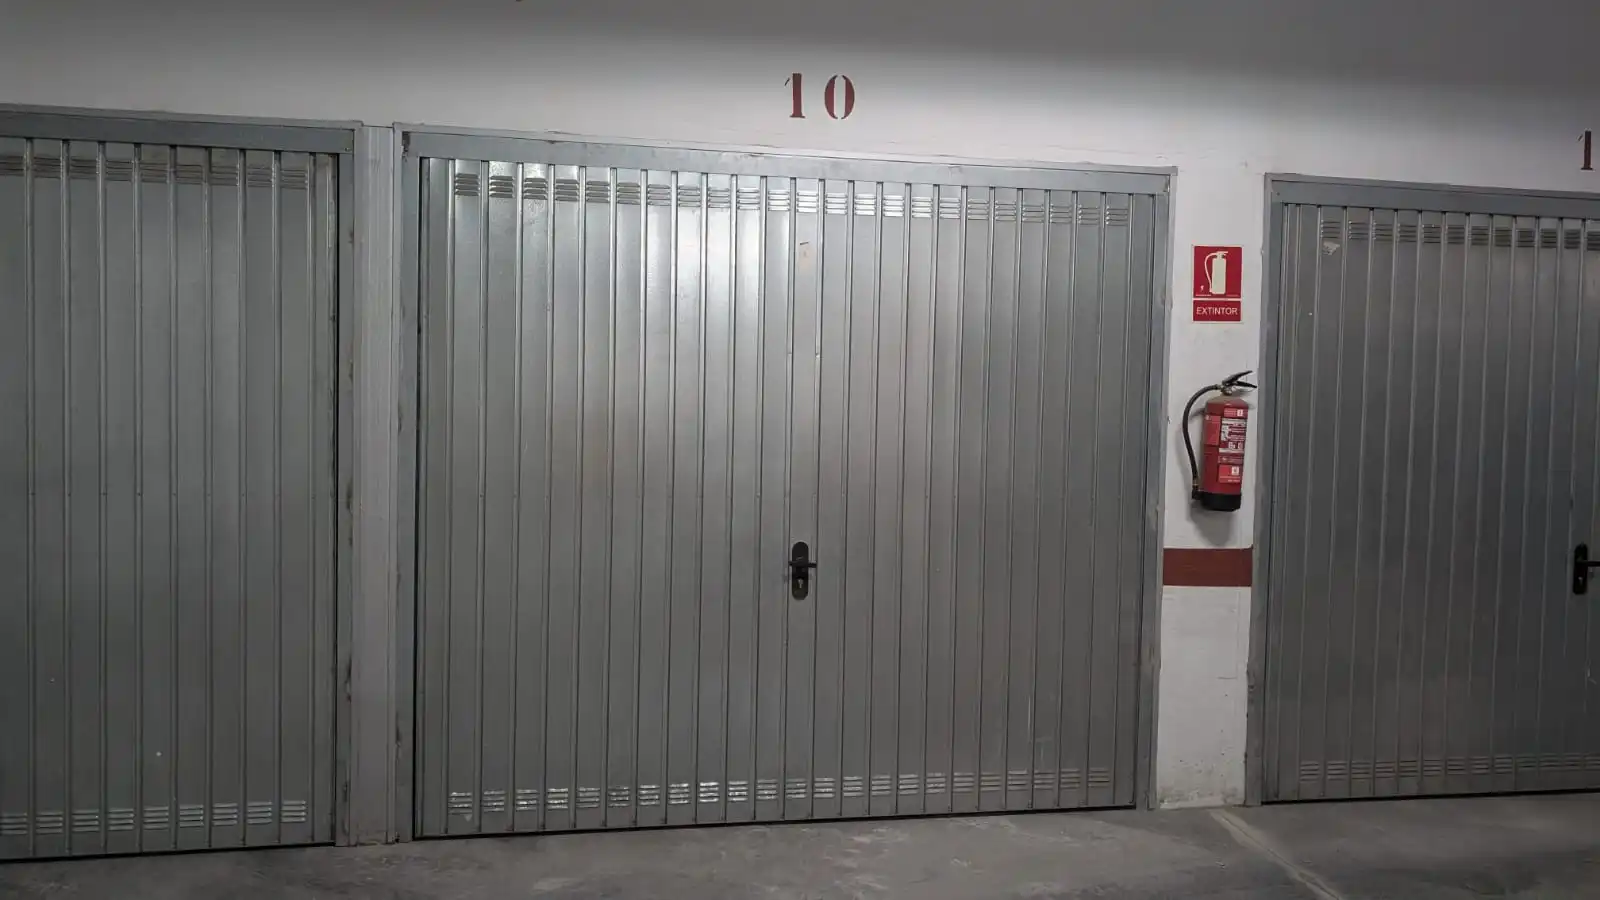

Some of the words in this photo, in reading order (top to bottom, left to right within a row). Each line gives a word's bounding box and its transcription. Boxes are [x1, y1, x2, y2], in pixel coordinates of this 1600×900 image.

[784, 73, 855, 119] 10
[1577, 130, 1594, 170] 1
[1196, 306, 1238, 316] EXTINTOR
